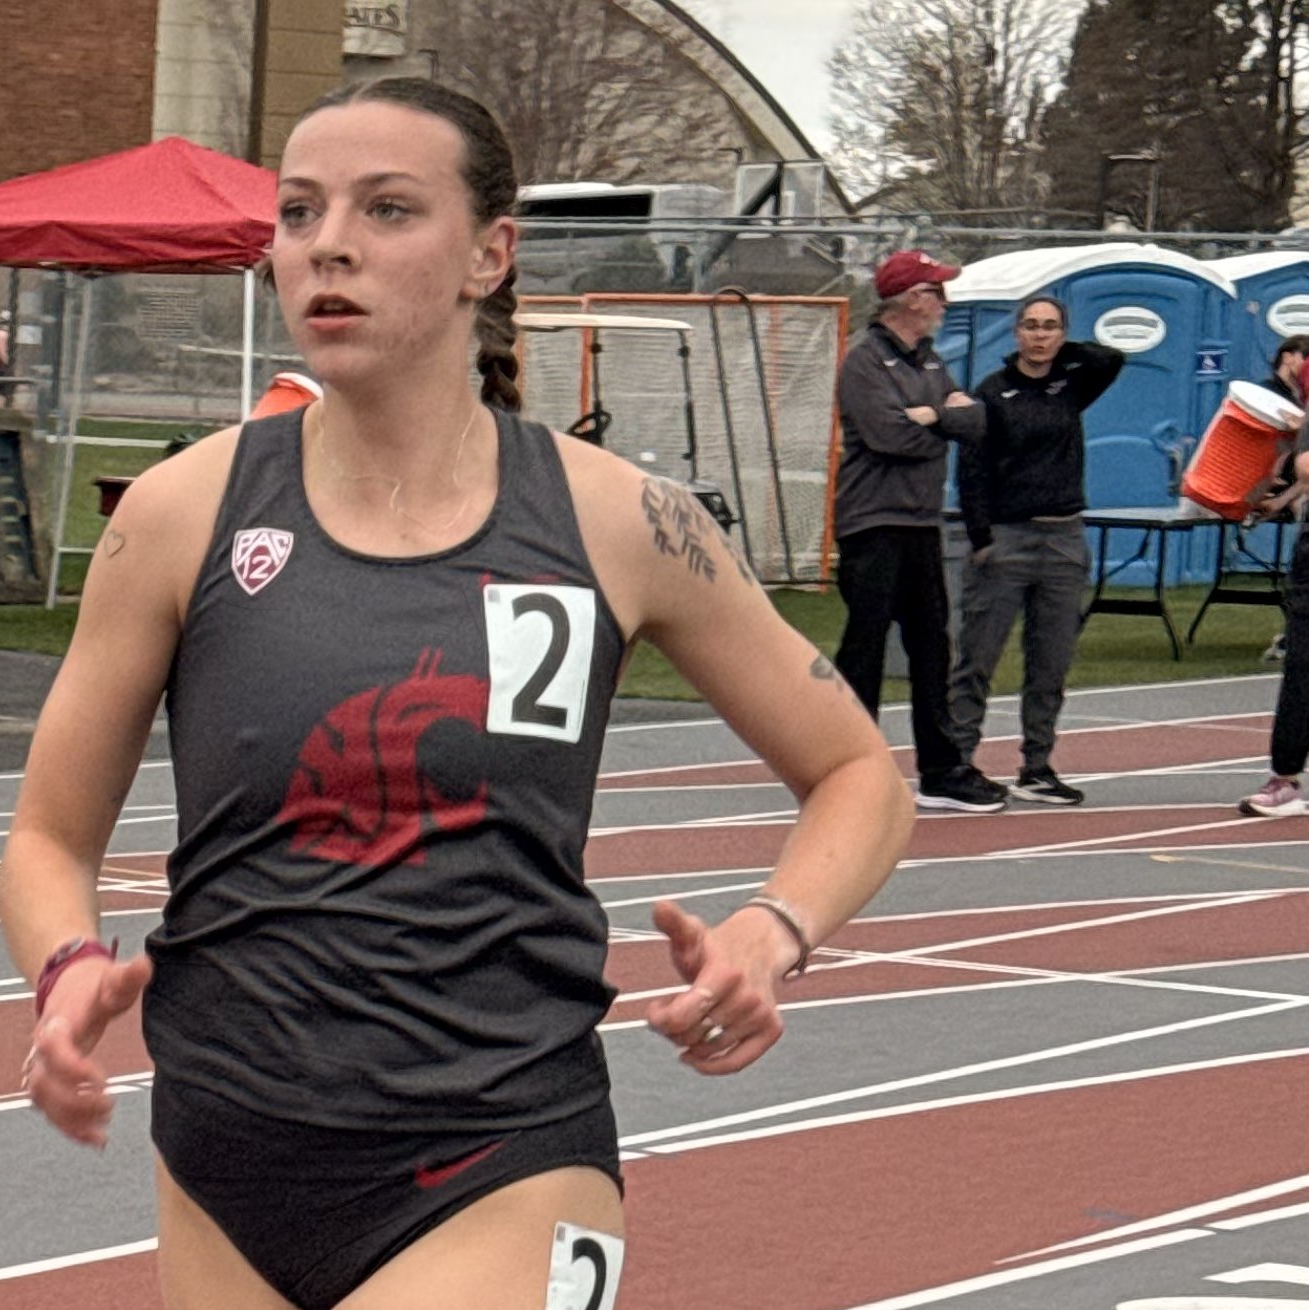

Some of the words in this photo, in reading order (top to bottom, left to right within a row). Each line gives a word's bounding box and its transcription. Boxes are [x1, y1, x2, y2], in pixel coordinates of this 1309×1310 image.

[236, 531, 290, 567] PAC
[242, 554, 273, 580] 12
[511, 592, 571, 730] 2
